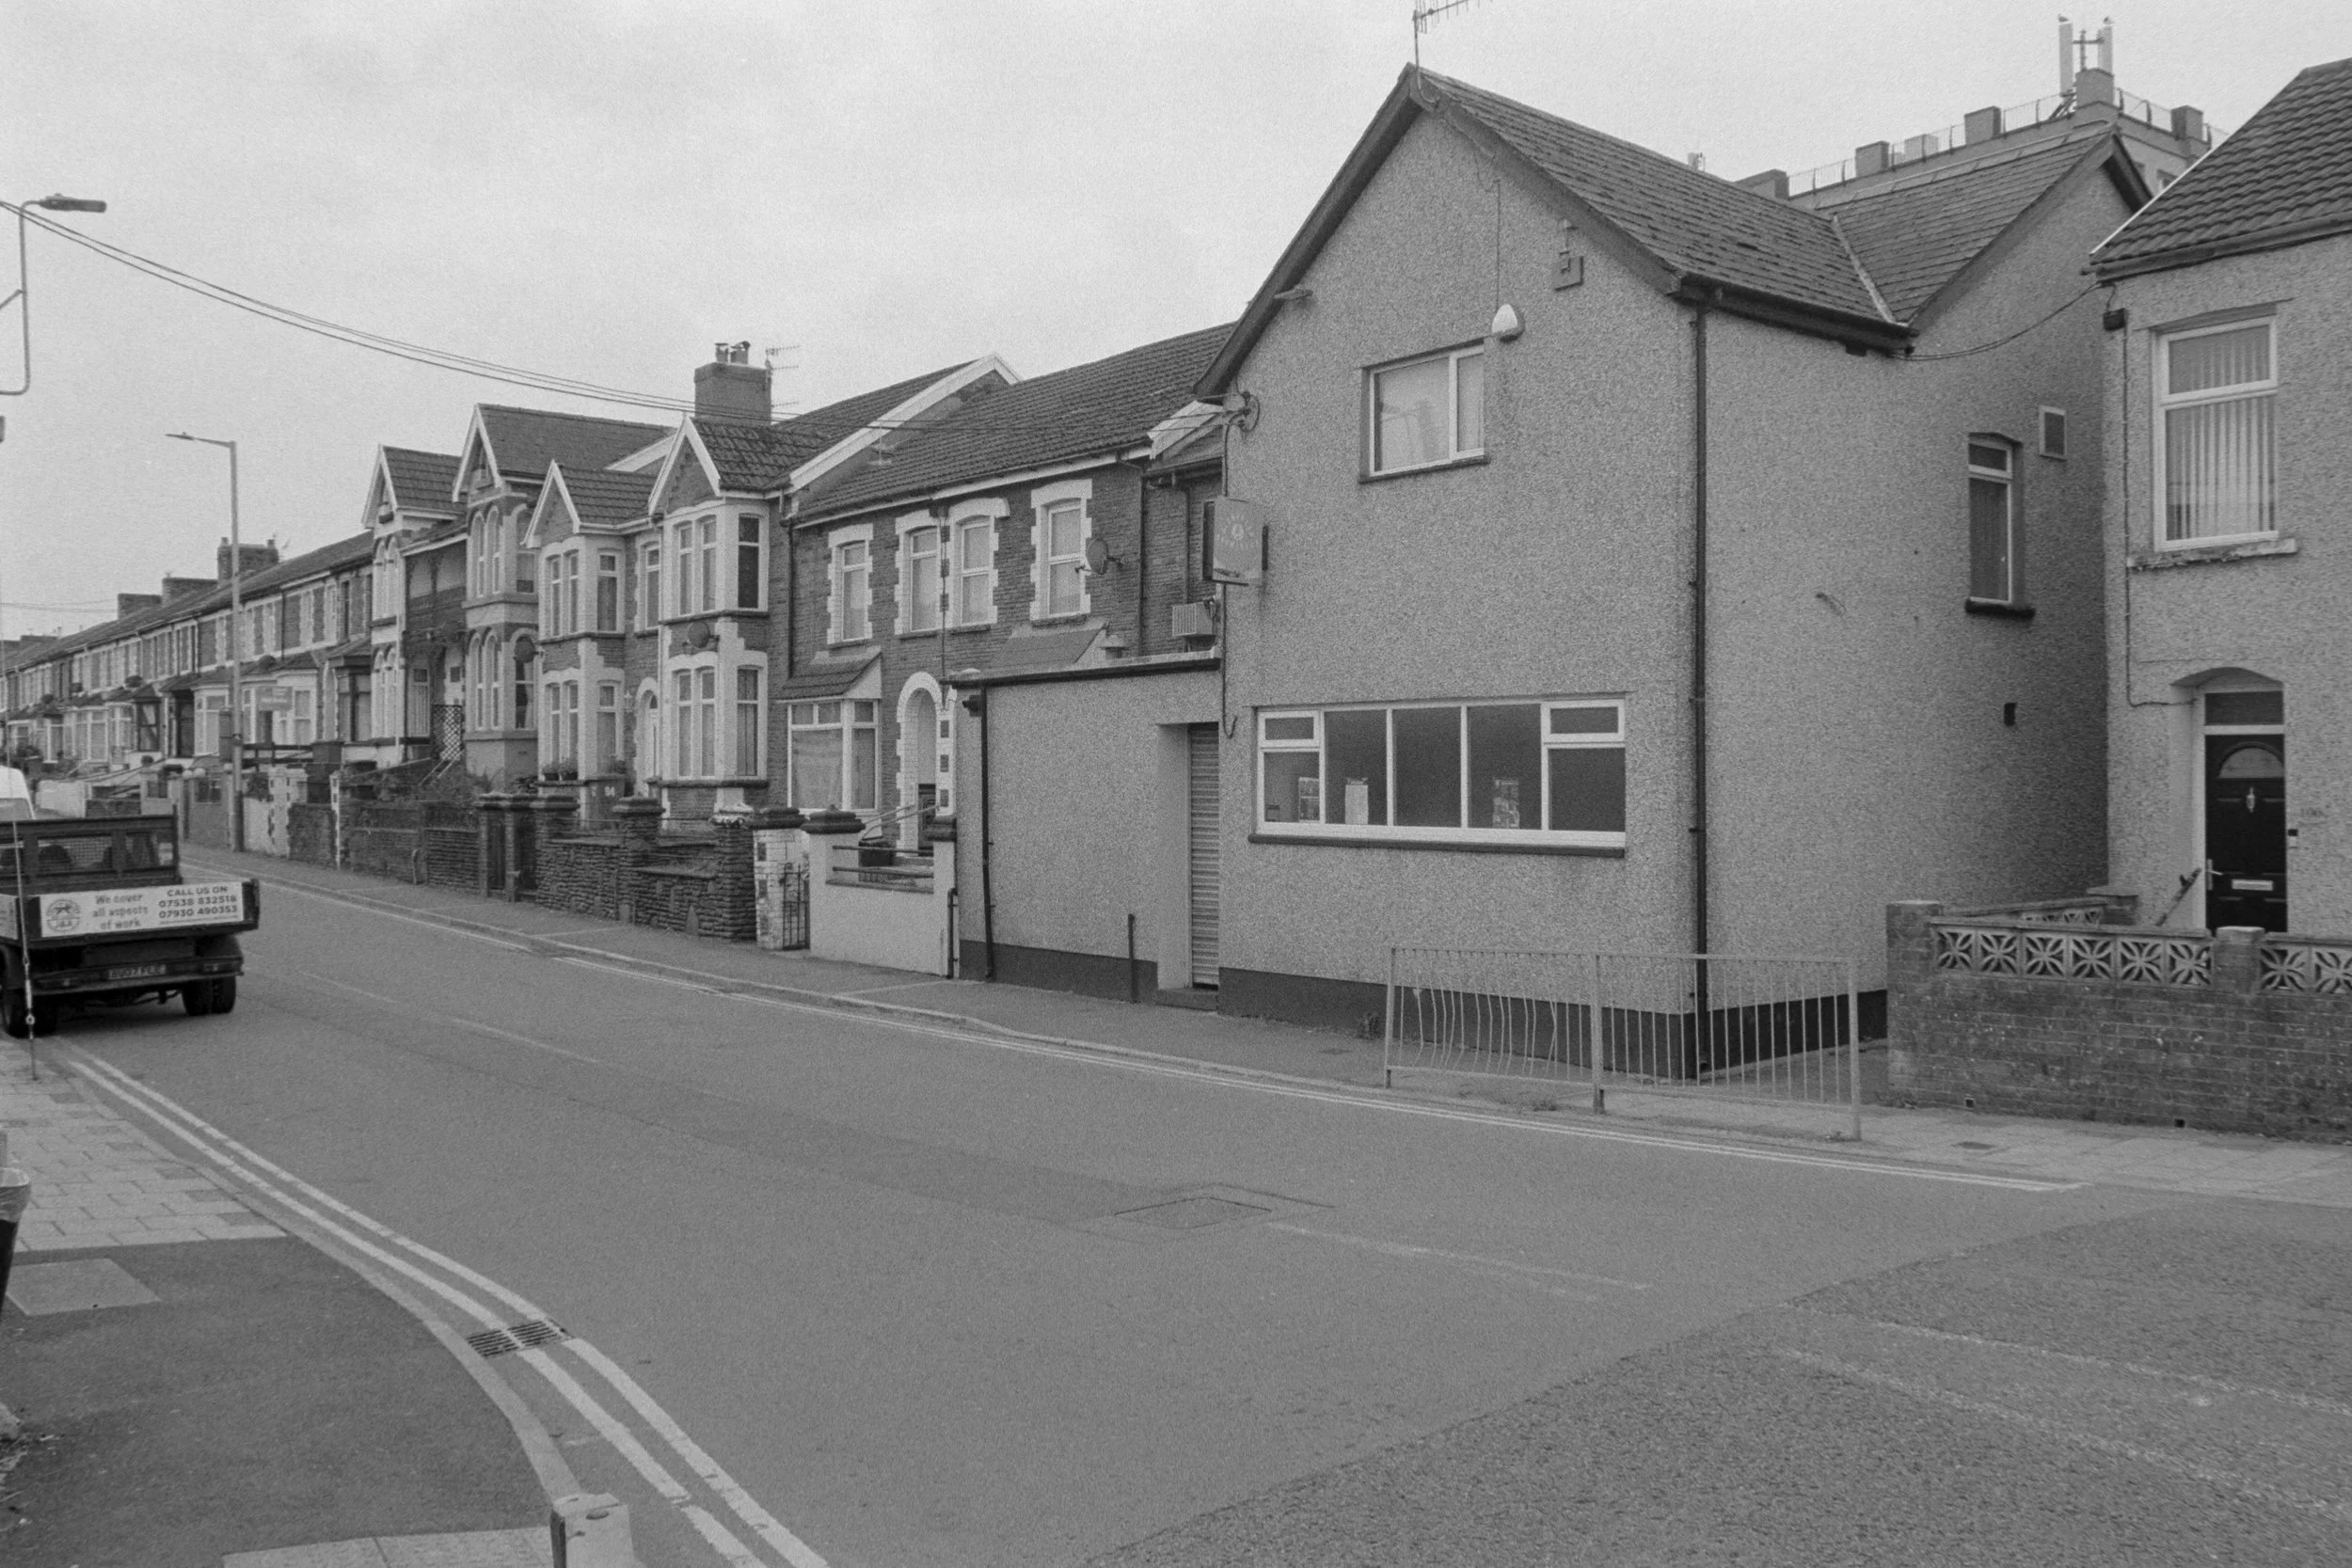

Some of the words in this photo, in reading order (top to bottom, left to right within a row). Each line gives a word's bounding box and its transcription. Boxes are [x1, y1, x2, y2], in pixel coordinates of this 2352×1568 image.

[167, 888, 194, 897] CALL
[196, 886, 210, 895] US
[212, 885, 228, 895] ON
[95, 895, 111, 904] We
[113, 893, 144, 903] cover
[92, 907, 106, 917] all
[108, 906, 149, 918] aspects
[158, 909, 194, 918] 07930
[198, 905, 237, 915] 490353
[100, 918, 113, 929] of
[115, 917, 141, 928] work
